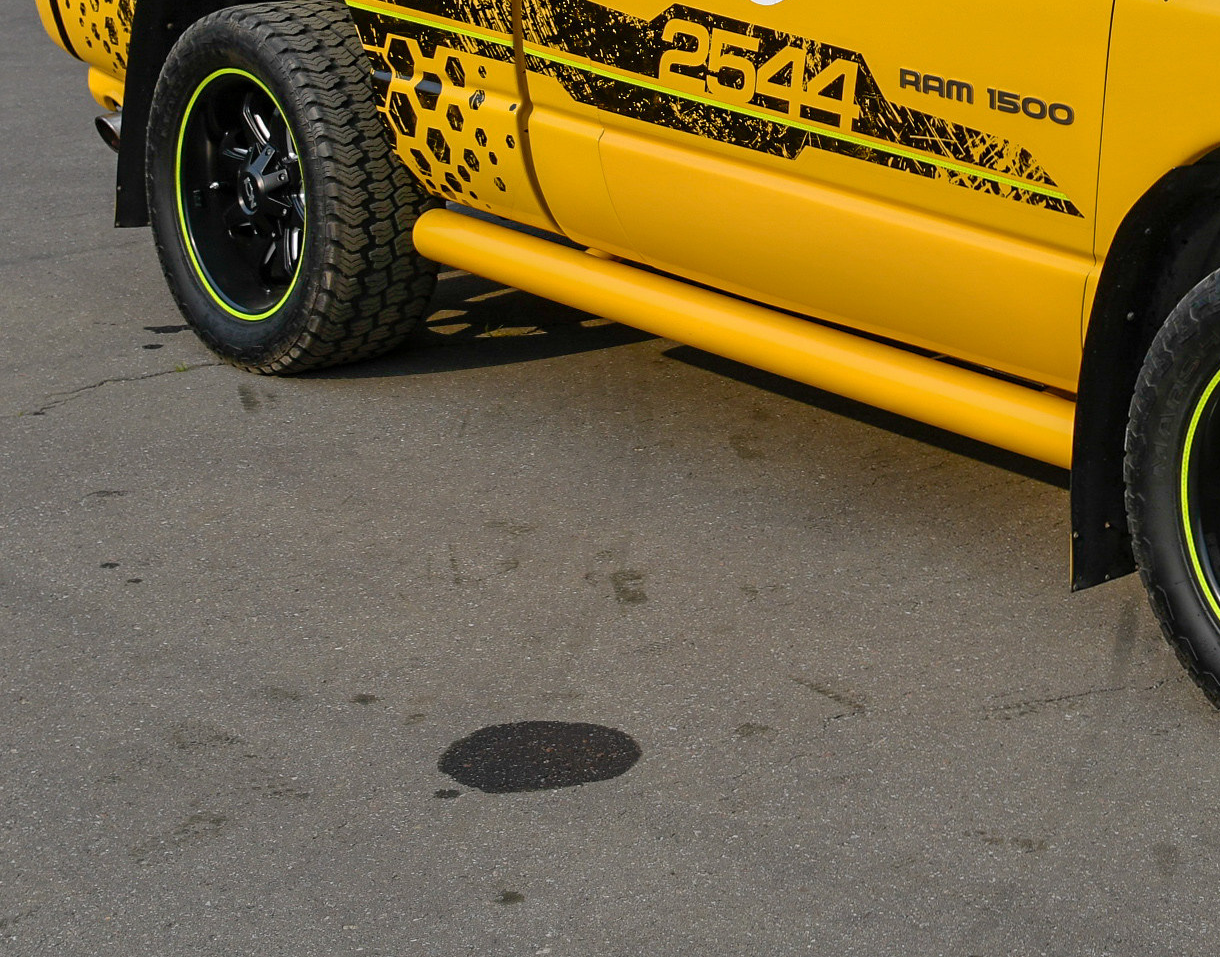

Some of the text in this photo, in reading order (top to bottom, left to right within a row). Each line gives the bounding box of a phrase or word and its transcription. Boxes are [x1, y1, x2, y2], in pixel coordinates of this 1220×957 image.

[658, 18, 862, 132] 2544
[900, 68, 1075, 126] RAM 1500
